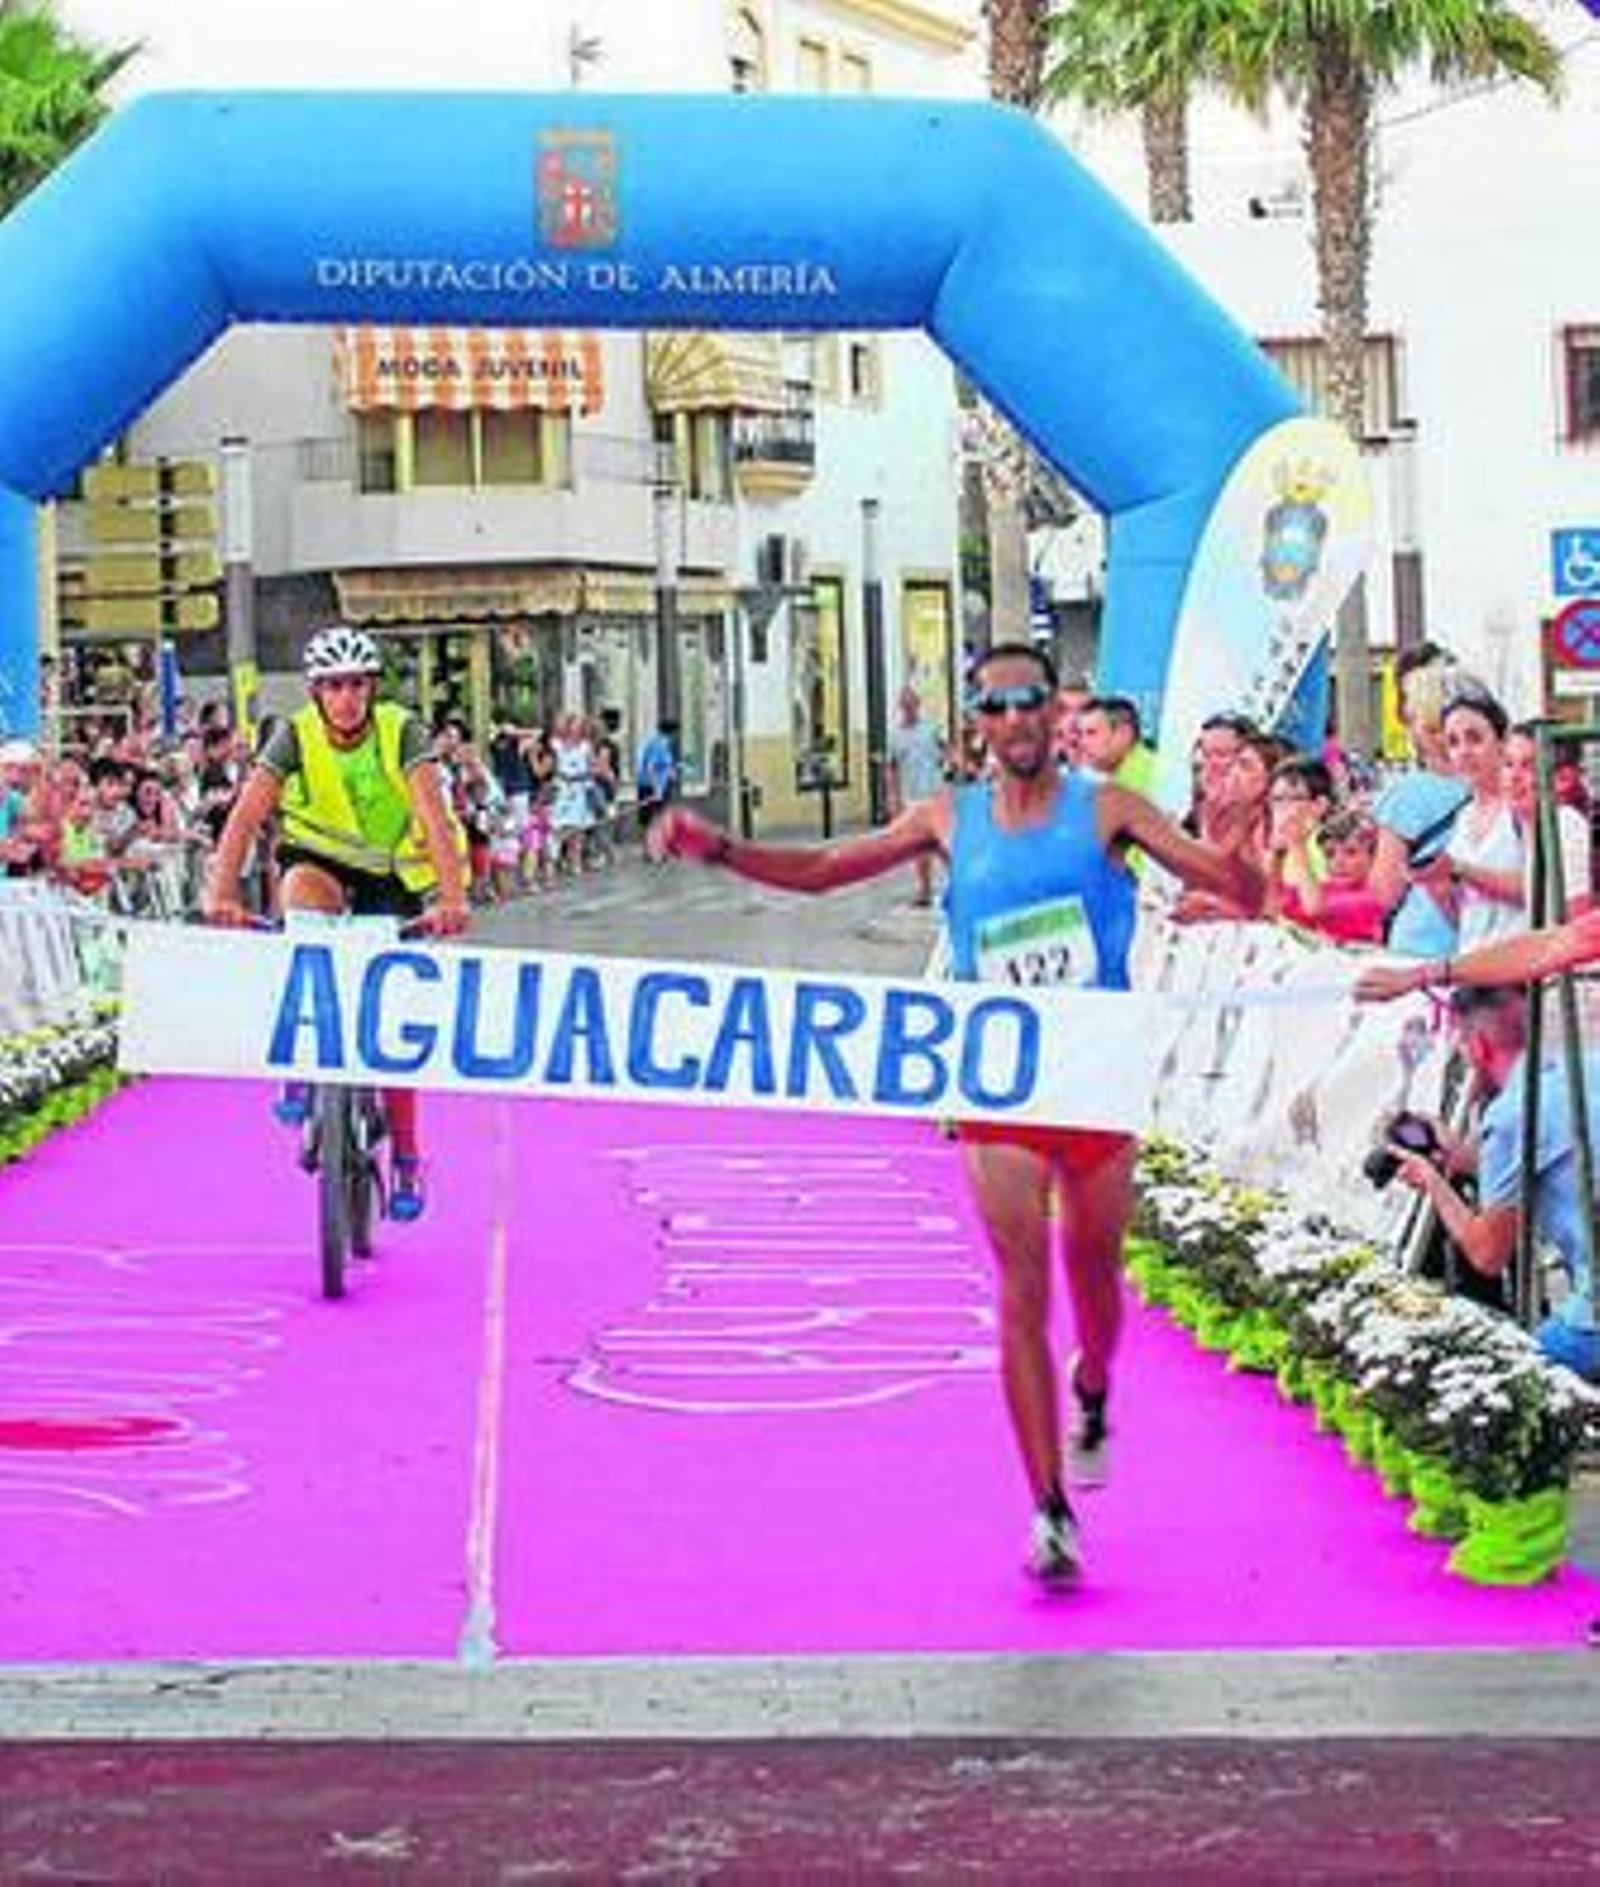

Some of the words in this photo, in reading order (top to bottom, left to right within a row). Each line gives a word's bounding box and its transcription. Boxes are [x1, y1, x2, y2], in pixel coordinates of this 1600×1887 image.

[316, 257, 568, 291] DIPUTACIÓN
[588, 264, 639, 292] DE
[659, 260, 837, 295] ALMERÍA
[473, 356, 583, 380] JUVENIL
[1006, 946, 1071, 988] 122
[266, 943, 1042, 1110] AGUACARBO
